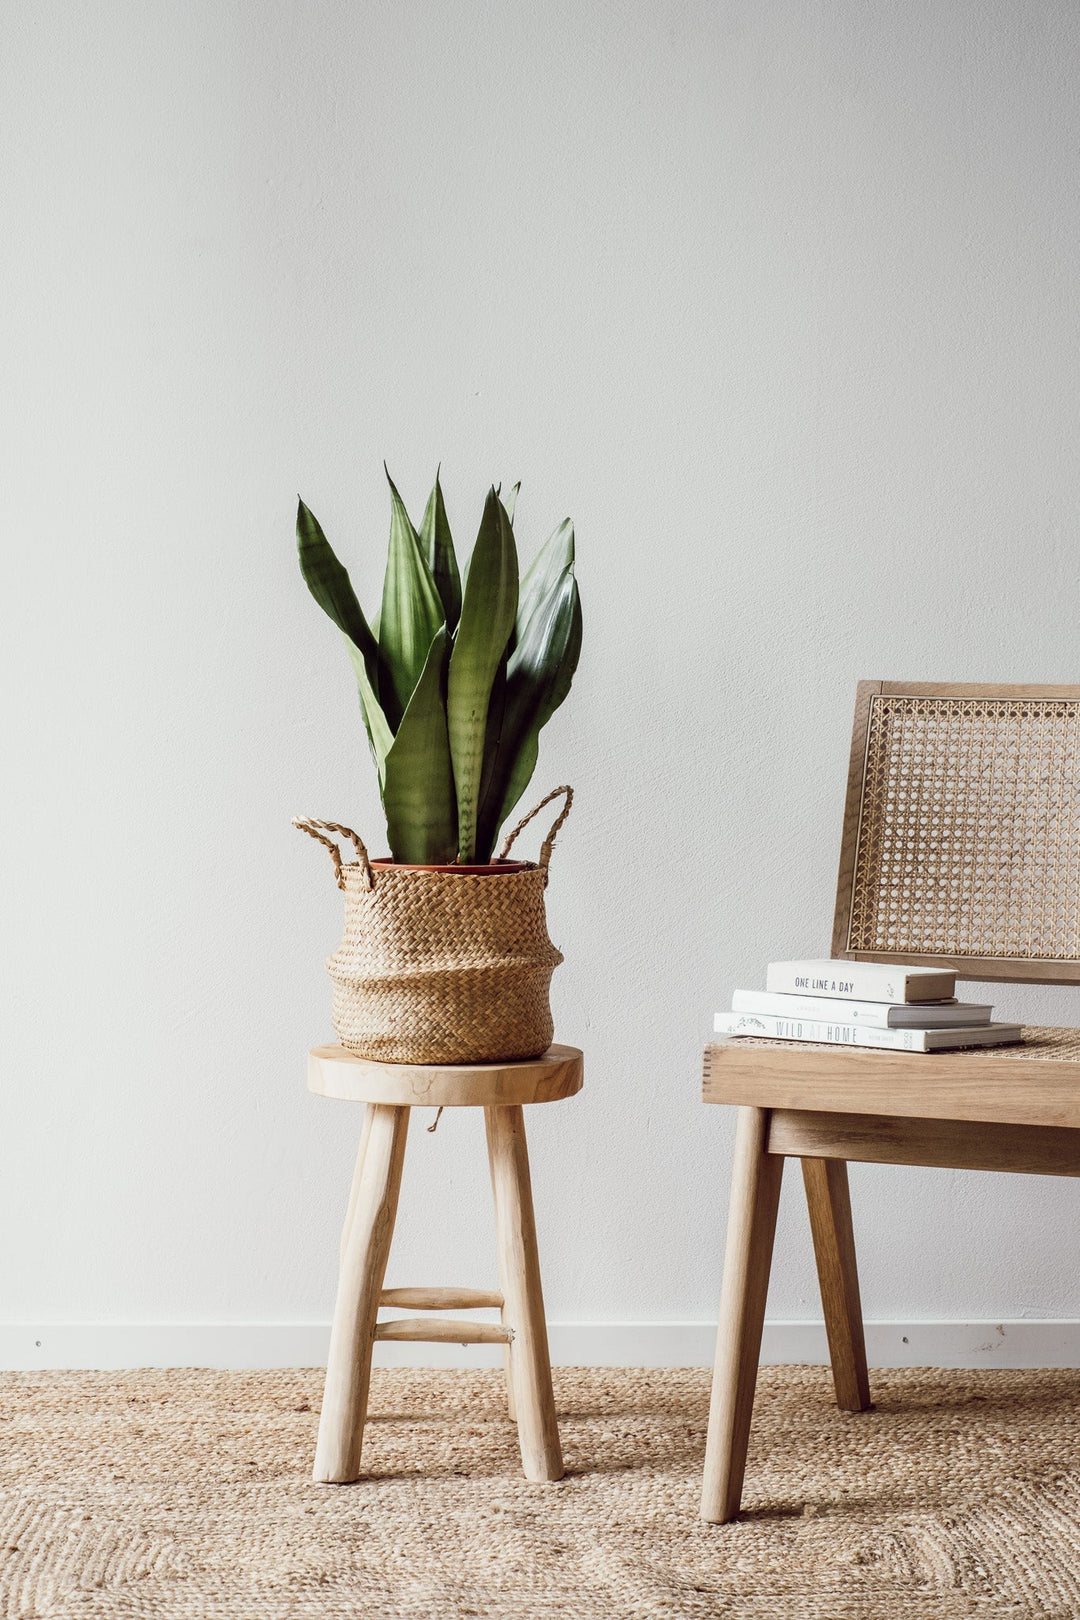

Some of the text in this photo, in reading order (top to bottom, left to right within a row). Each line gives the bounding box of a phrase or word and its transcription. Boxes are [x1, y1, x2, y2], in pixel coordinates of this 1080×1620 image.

[795, 977, 854, 992] ONE LINE A DAY
[776, 1021, 803, 1038] WILD
[827, 1026, 857, 1043] HOME
